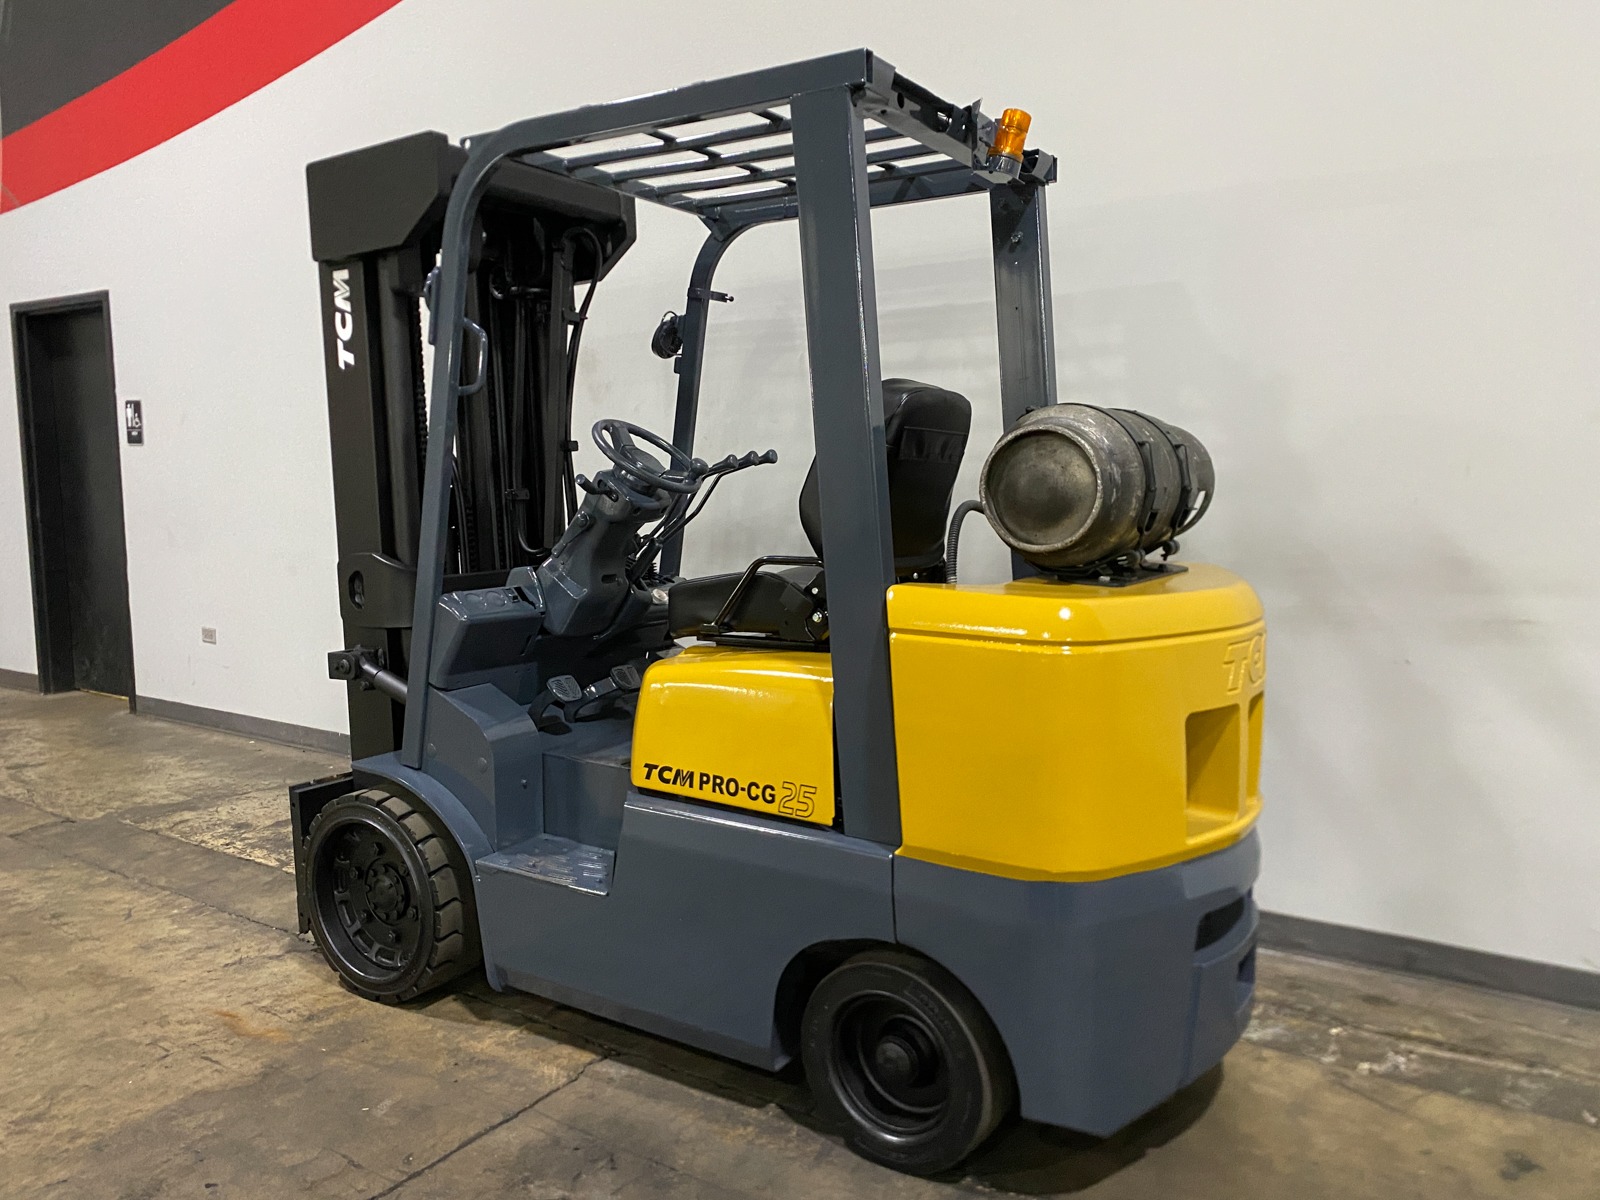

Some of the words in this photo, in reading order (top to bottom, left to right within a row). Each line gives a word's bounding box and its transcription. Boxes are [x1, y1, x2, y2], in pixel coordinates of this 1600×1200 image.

[332, 268, 355, 370] TCM
[1222, 632, 1266, 694] TC
[643, 763, 694, 788] TCM
[698, 772, 776, 804] PRO-CG
[778, 781, 818, 818] 25
